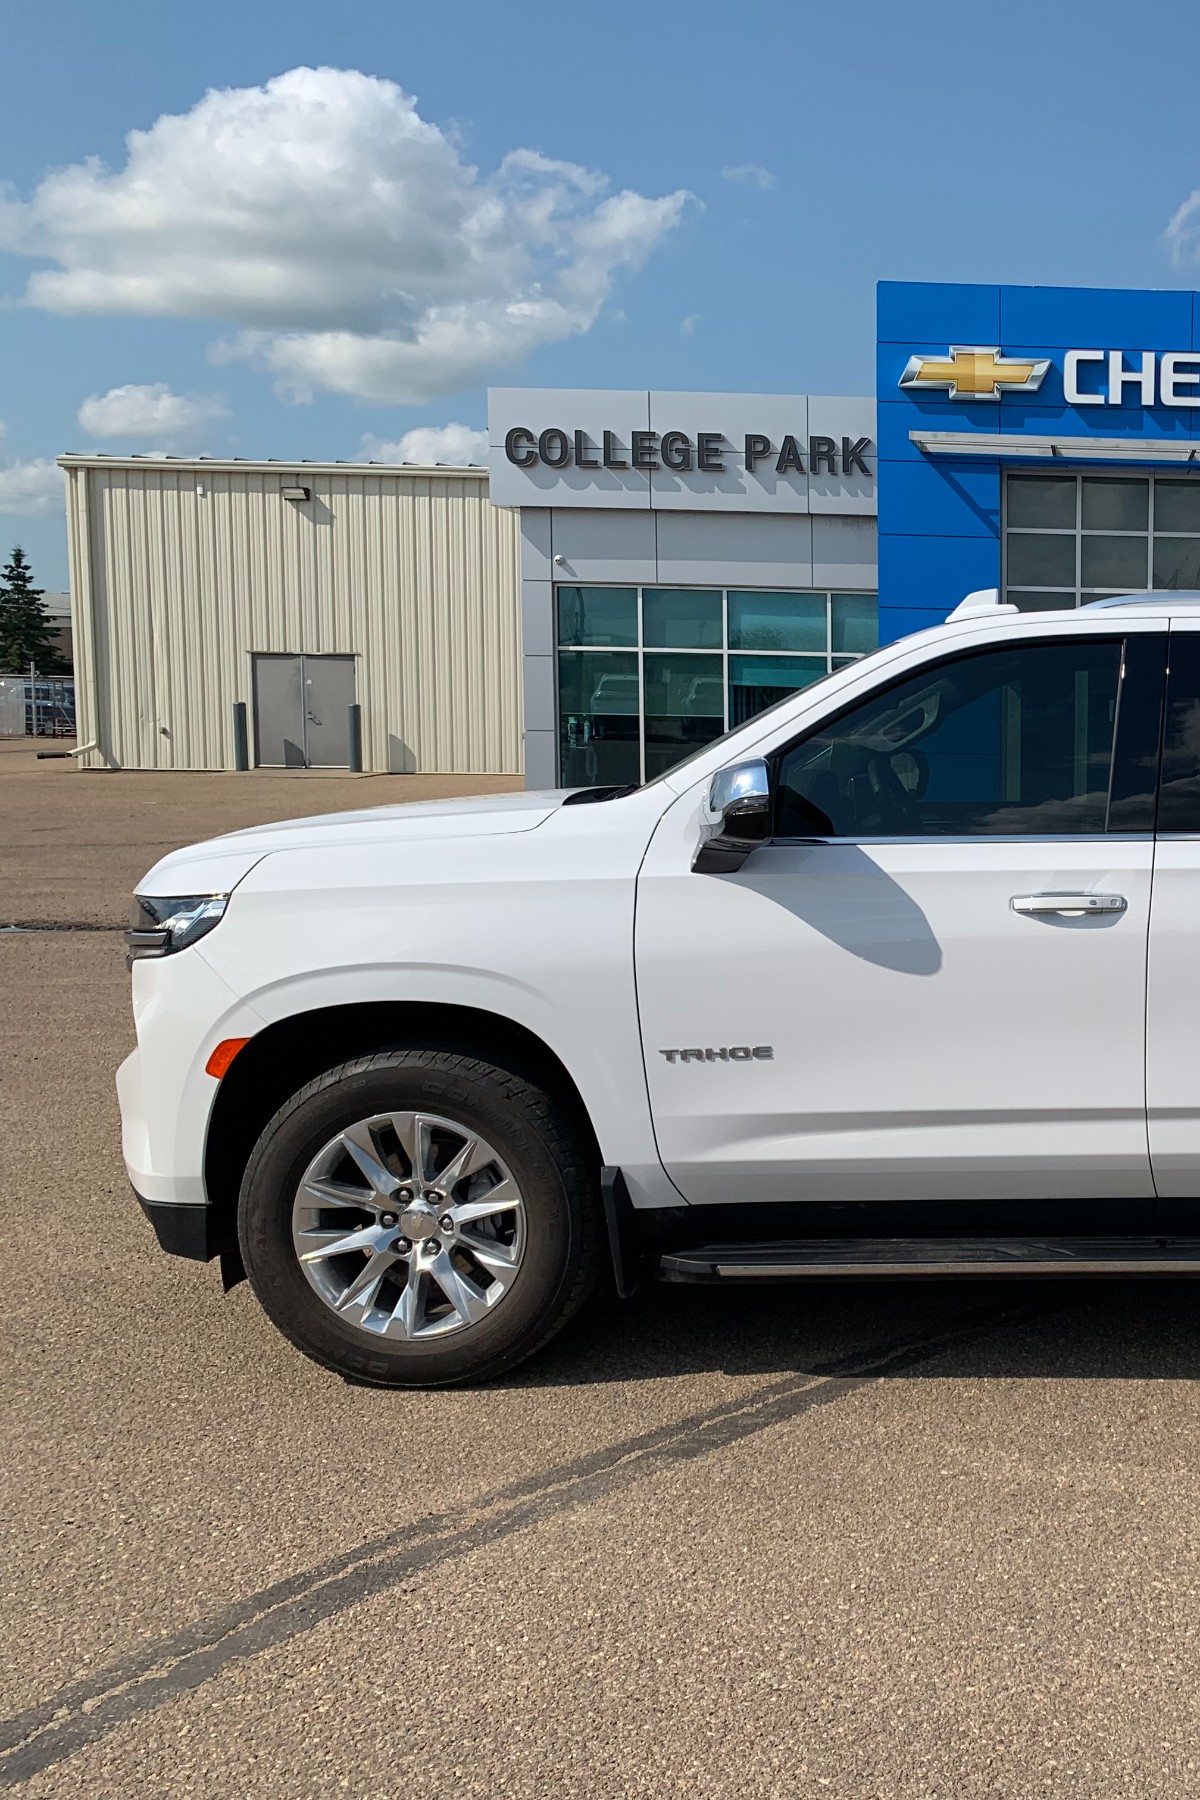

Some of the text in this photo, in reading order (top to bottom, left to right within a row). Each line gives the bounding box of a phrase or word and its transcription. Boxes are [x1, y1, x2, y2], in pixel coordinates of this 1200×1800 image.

[505, 427, 872, 476] COLLEGE PARK
[658, 1046, 775, 1064] TAHOE
